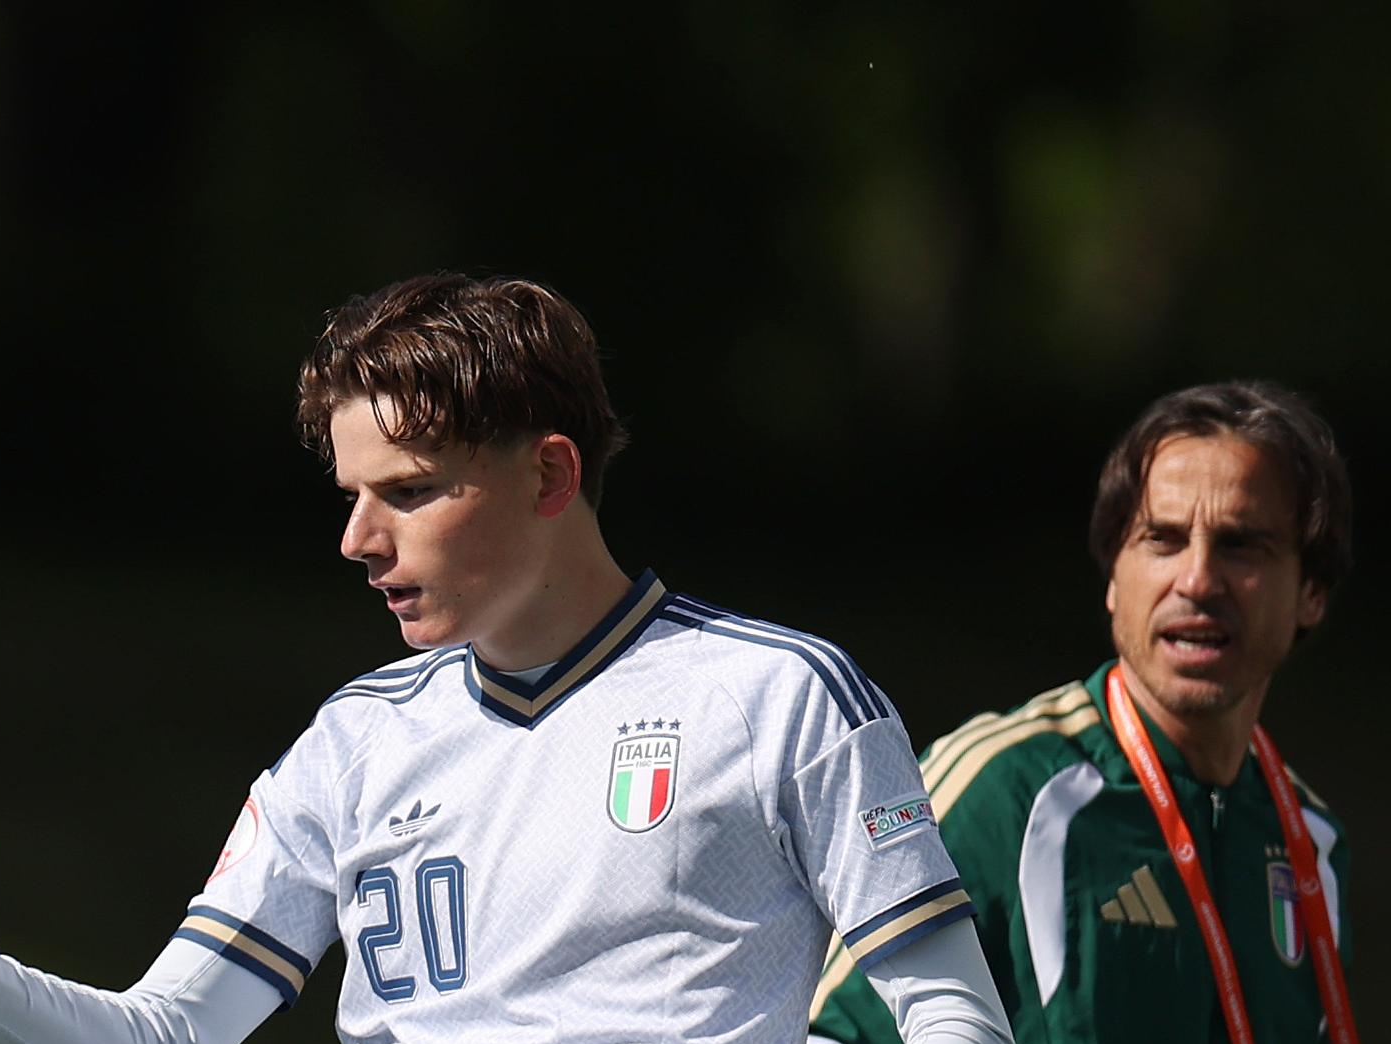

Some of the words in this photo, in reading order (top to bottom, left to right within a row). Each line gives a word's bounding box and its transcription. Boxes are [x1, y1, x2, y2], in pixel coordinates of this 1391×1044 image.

[618, 741, 672, 761] ITALIA
[863, 806, 886, 822] UEFA
[355, 855, 470, 1005] 20
